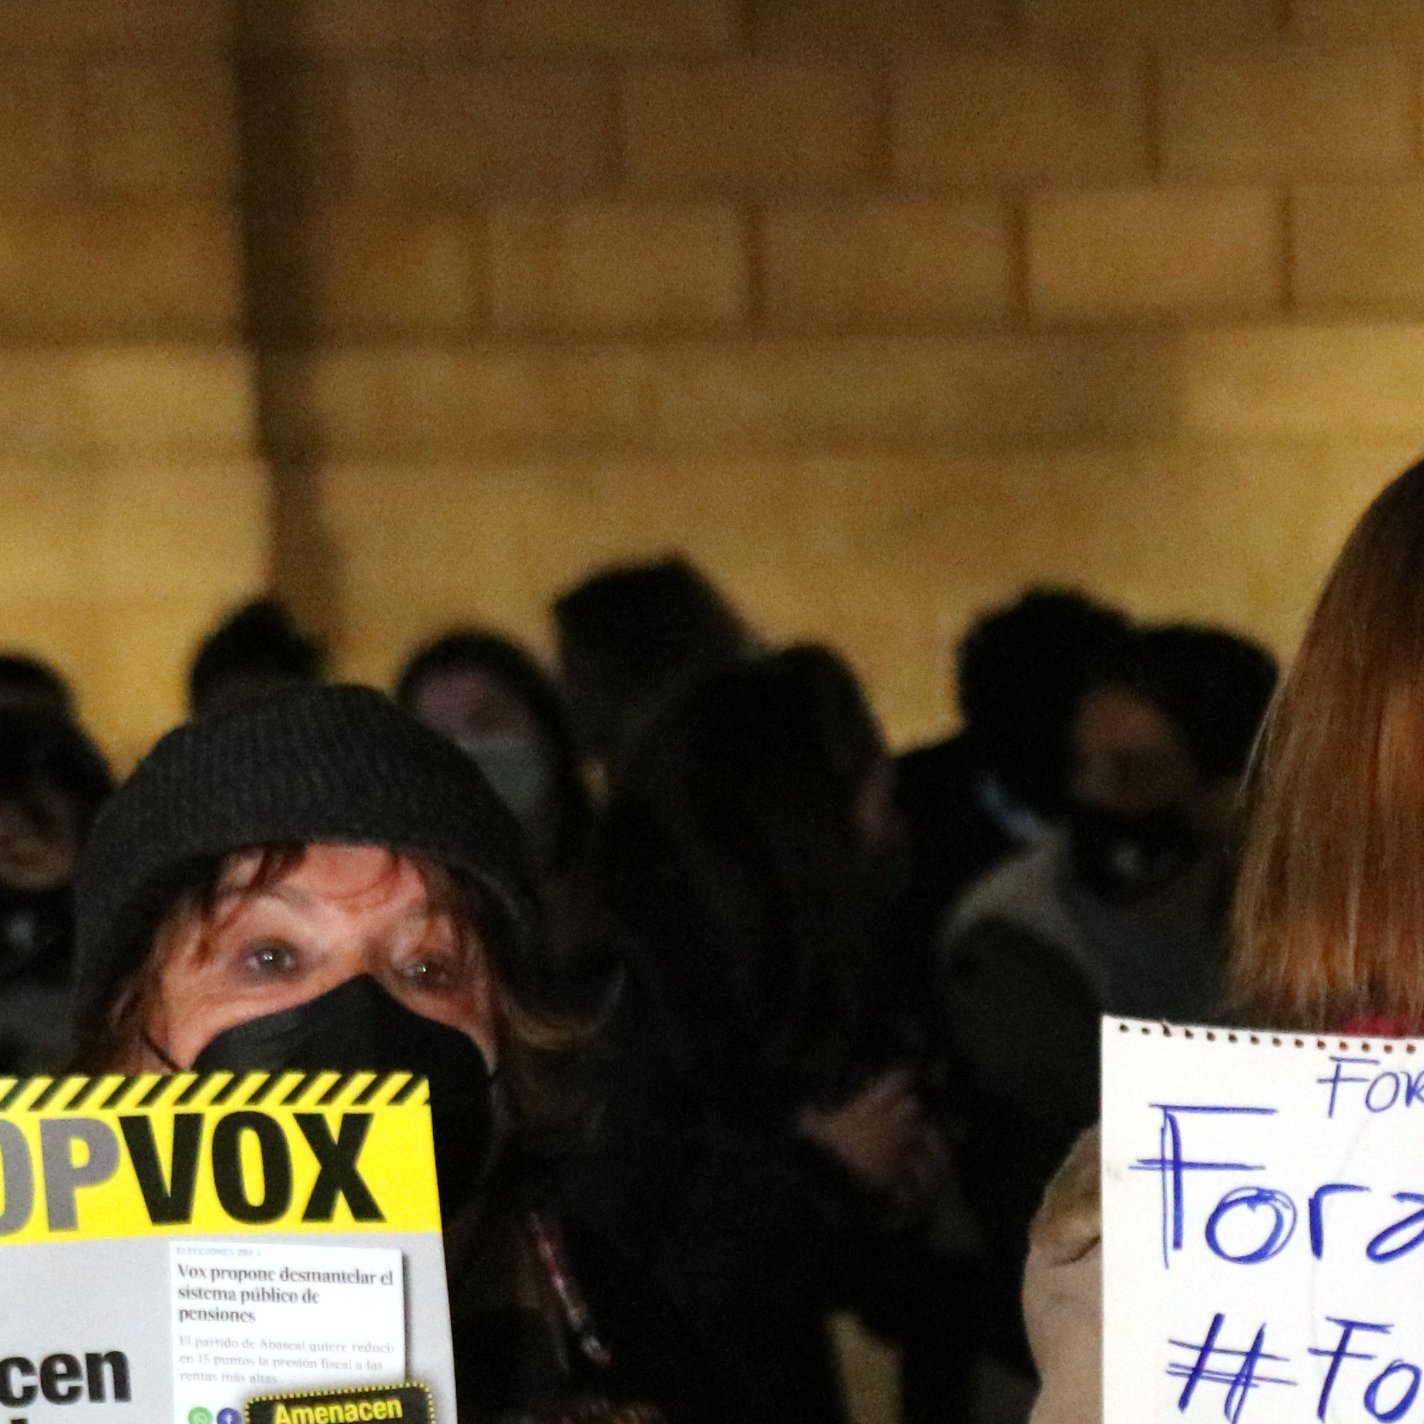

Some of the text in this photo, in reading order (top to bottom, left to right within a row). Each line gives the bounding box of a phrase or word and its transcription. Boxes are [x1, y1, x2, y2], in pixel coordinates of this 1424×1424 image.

[177, 1263, 393, 1286] Vox propone desmantelar el
[178, 1285, 320, 1305] sistema público de
[178, 1307, 256, 1323] pensiones
